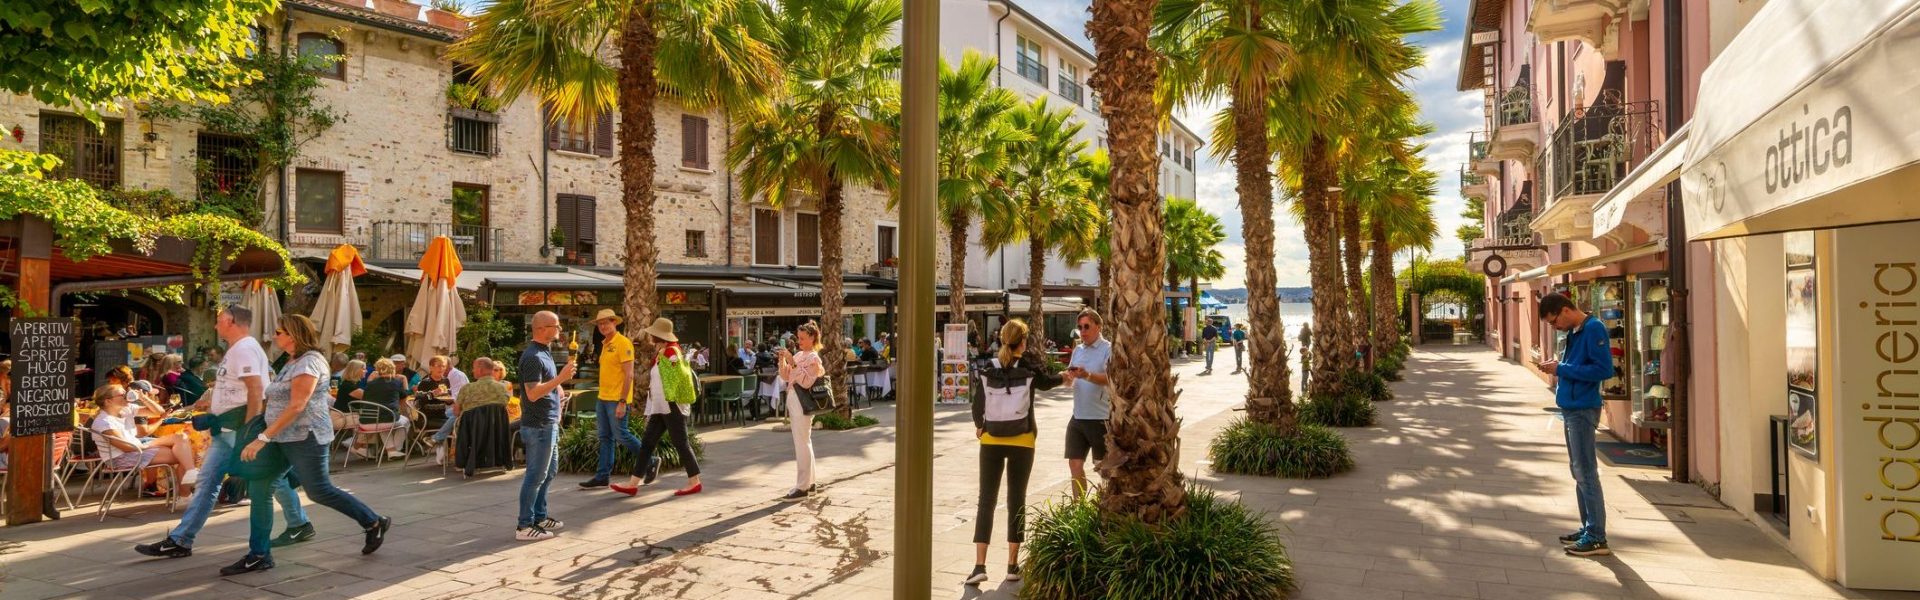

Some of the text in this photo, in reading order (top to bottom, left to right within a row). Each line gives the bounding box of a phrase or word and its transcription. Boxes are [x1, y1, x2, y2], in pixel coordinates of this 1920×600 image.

[1765, 104, 1853, 195] ottica
[13, 322, 72, 335] APERITIVI
[21, 336, 69, 348] APEROL
[19, 349, 70, 362] SPRITZ
[27, 361, 67, 375] HUGO
[21, 375, 66, 389] BERTO
[17, 388, 69, 403] NEGRONI
[1859, 262, 1920, 542] piadineria
[16, 402, 71, 418] PROSECCO
